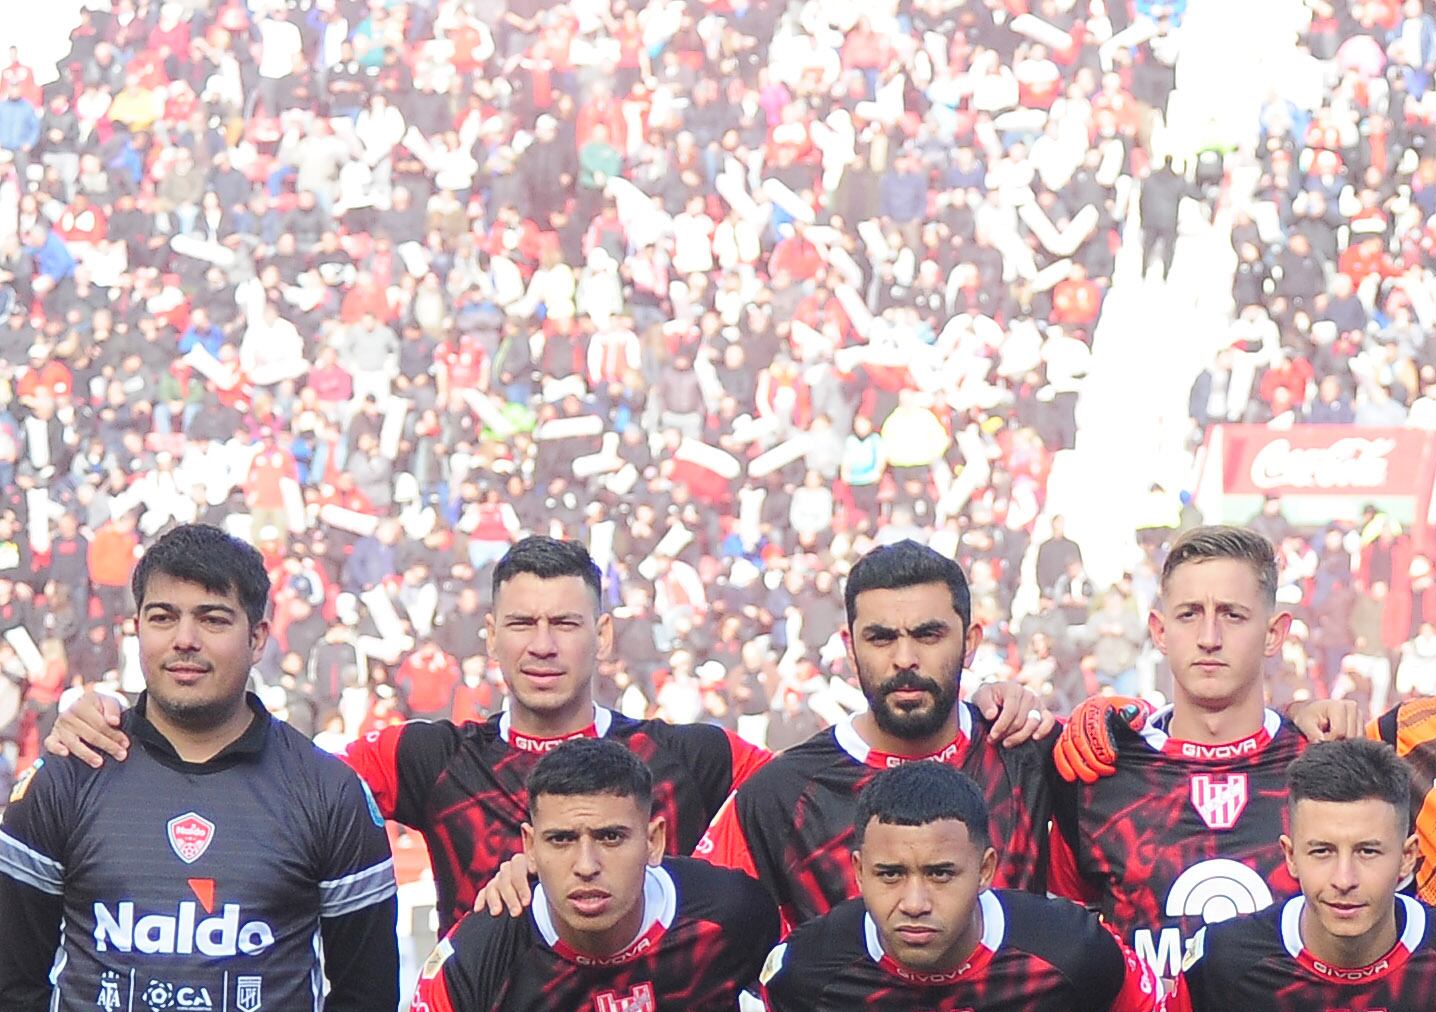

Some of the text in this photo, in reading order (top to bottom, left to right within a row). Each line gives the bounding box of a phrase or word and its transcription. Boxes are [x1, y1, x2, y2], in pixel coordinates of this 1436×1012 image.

[1182, 738, 1257, 759] GIVOVA
[93, 901, 276, 958] Naldo
[576, 937, 651, 966] GIVOVA
[1313, 959, 1390, 980] GIVOVA
